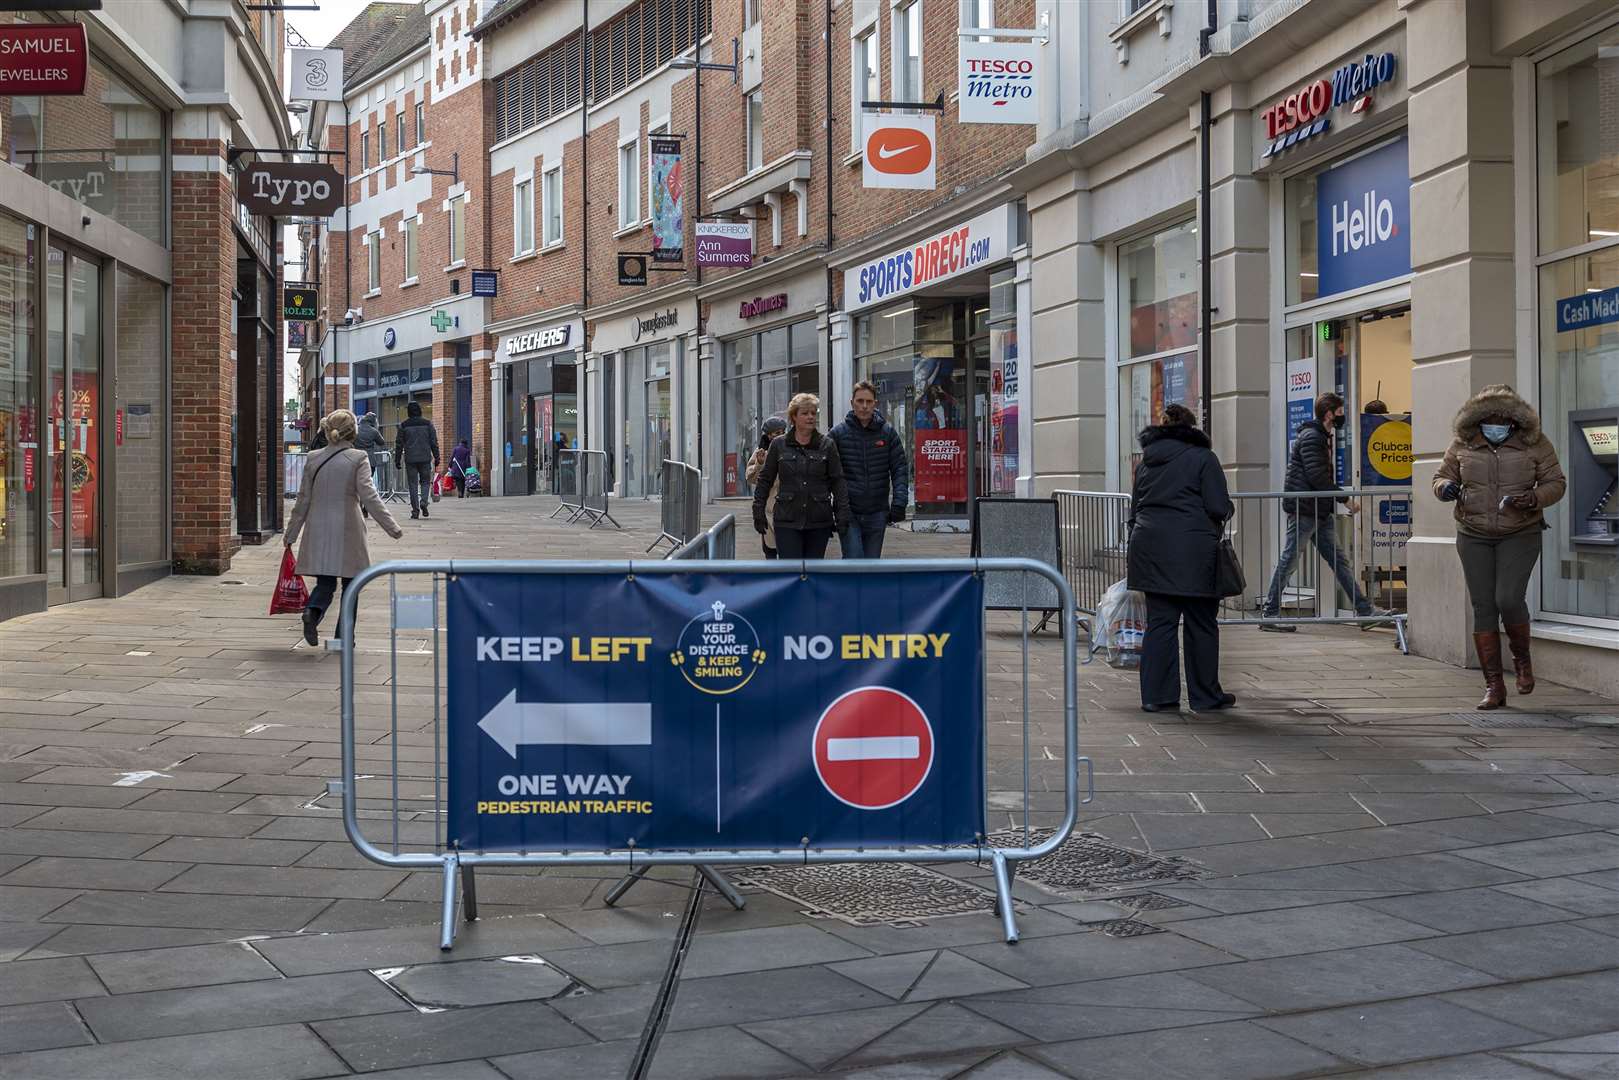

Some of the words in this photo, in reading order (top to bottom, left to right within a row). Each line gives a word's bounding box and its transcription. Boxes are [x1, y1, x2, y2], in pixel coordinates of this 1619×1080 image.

[1, 38, 76, 54] SAMUEL
[966, 59, 1033, 74] TESCO
[0, 68, 69, 81] EWELLERS
[967, 80, 1033, 99] Metro
[1260, 80, 1331, 141] TESCO
[1331, 52, 1395, 108] Metro
[252, 171, 331, 205] Typo
[697, 225, 750, 235] KNICKERBOX
[1332, 190, 1399, 257] Hello.
[698, 240, 721, 251] Ann
[698, 250, 750, 263] Summers
[1563, 302, 1590, 324] Cash
[1593, 291, 1619, 319] Mach
[505, 324, 571, 355] SKECHERS
[1005, 360, 1018, 377] 20
[1290, 371, 1312, 386] TESCO
[1005, 382, 1018, 398] OF
[925, 439, 957, 447] SPORT
[1589, 432, 1609, 442] TESCO
[922, 446, 960, 454] STARTS
[1372, 441, 1411, 452] Clubcar
[1381, 453, 1413, 463] Prices
[1372, 529, 1387, 538] The
[703, 623, 735, 634] KEEP
[702, 634, 737, 645] YOUR
[783, 634, 834, 661] NO
[840, 632, 951, 660] ENTRY
[476, 636, 564, 662] KEEP
[571, 636, 653, 662] LEFT
[688, 644, 749, 656] DISTANCE
[698, 656, 707, 666] &
[709, 655, 740, 666] KEEP
[694, 666, 743, 678] SMILING
[498, 774, 557, 796] ONE
[562, 774, 632, 796] WAY
[477, 800, 580, 815] PEDESTRIAN
[582, 800, 654, 814] TRAFFIC
